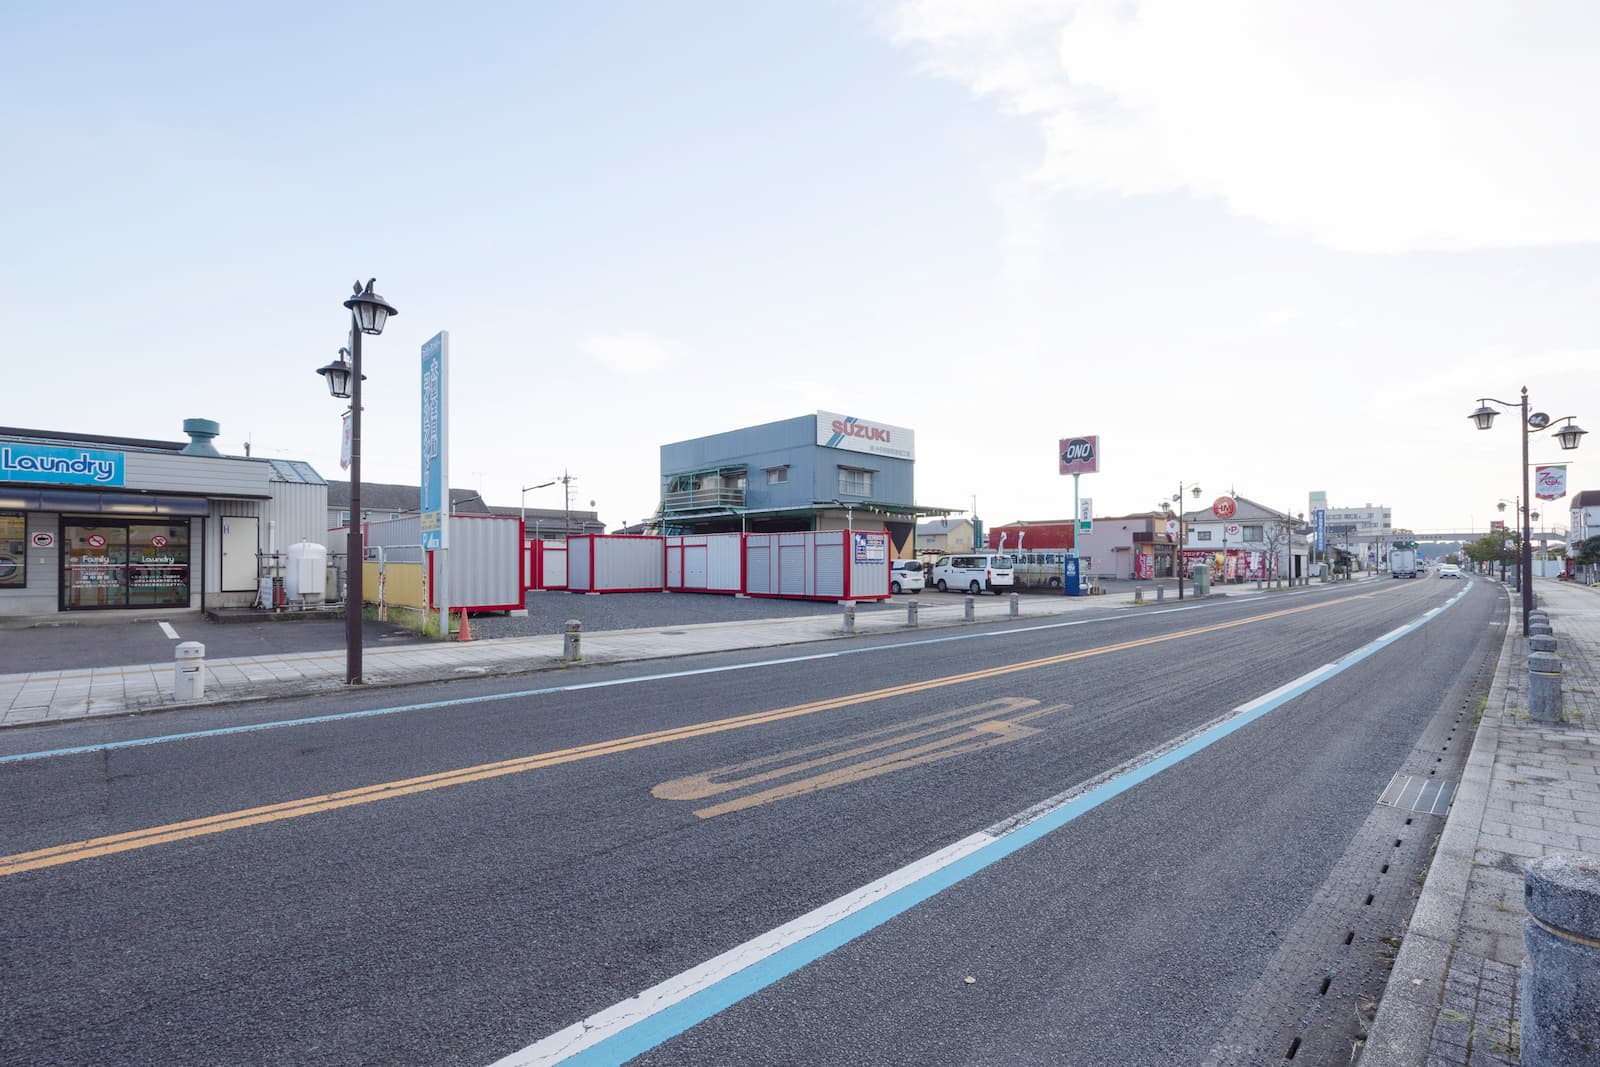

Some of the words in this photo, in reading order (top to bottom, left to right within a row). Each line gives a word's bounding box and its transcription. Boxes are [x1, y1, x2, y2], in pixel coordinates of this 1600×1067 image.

[832, 421, 891, 443] SUZUKI
[1067, 444, 1090, 458] ONO
[2, 448, 114, 481] Laundry
[82, 555, 110, 565] Family
[141, 555, 175, 565] Laundry
